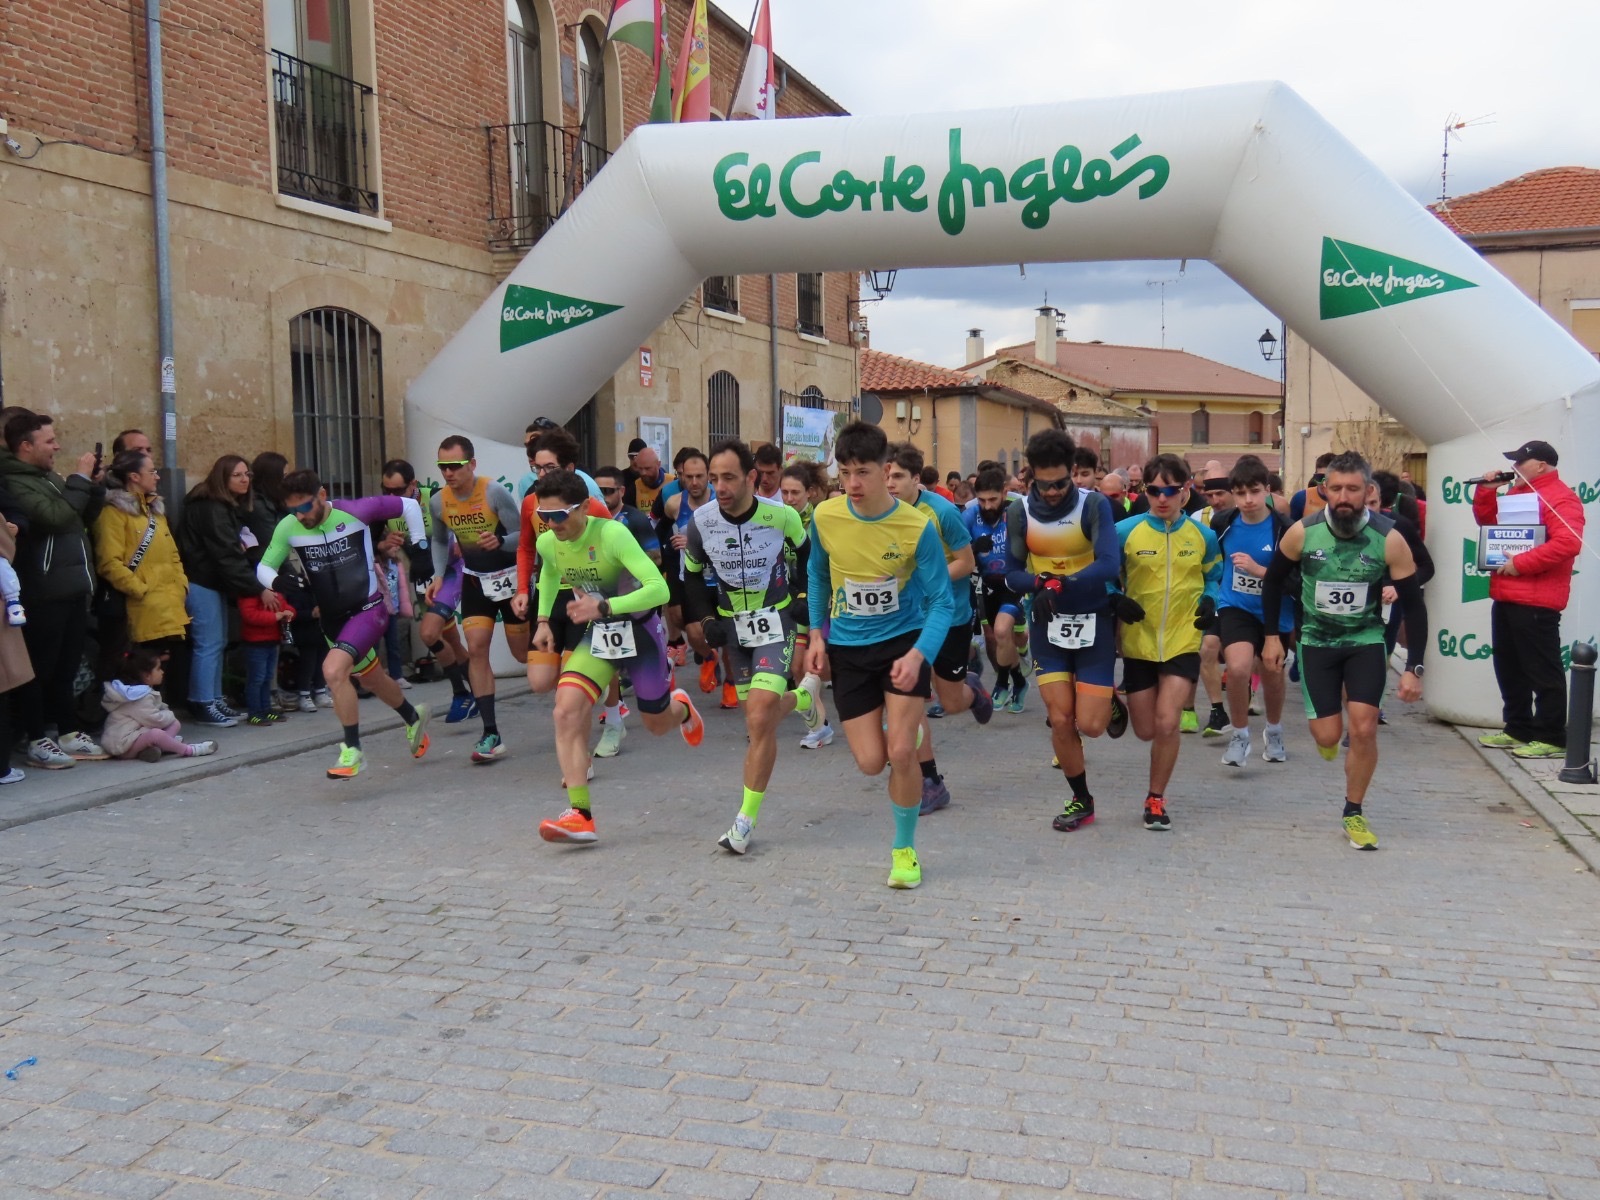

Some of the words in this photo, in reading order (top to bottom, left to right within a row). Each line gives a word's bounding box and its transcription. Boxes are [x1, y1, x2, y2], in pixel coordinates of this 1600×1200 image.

[713, 152, 776, 221] El
[779, 151, 928, 219] Corte
[937, 127, 1170, 236] Inglés
[1323, 268, 1340, 287] El
[1342, 270, 1383, 287] Corte
[1384, 265, 1444, 294] Inglés
[503, 306, 514, 321] El
[515, 306, 545, 321] Corte
[546, 301, 593, 325] Inglés
[1442, 476, 1462, 504] El
[448, 512, 486, 527] TORRES
[1501, 543, 1533, 551] SALAMANCA
[720, 558, 767, 570] RODRÍGUEZ
[1465, 563, 1477, 576] El
[492, 577, 513, 592] 34
[852, 591, 893, 606] 103
[1328, 591, 1355, 605] 30
[747, 618, 770, 635] 18
[1060, 623, 1085, 638] 57
[603, 632, 623, 648] 10
[1438, 629, 1457, 657] El
